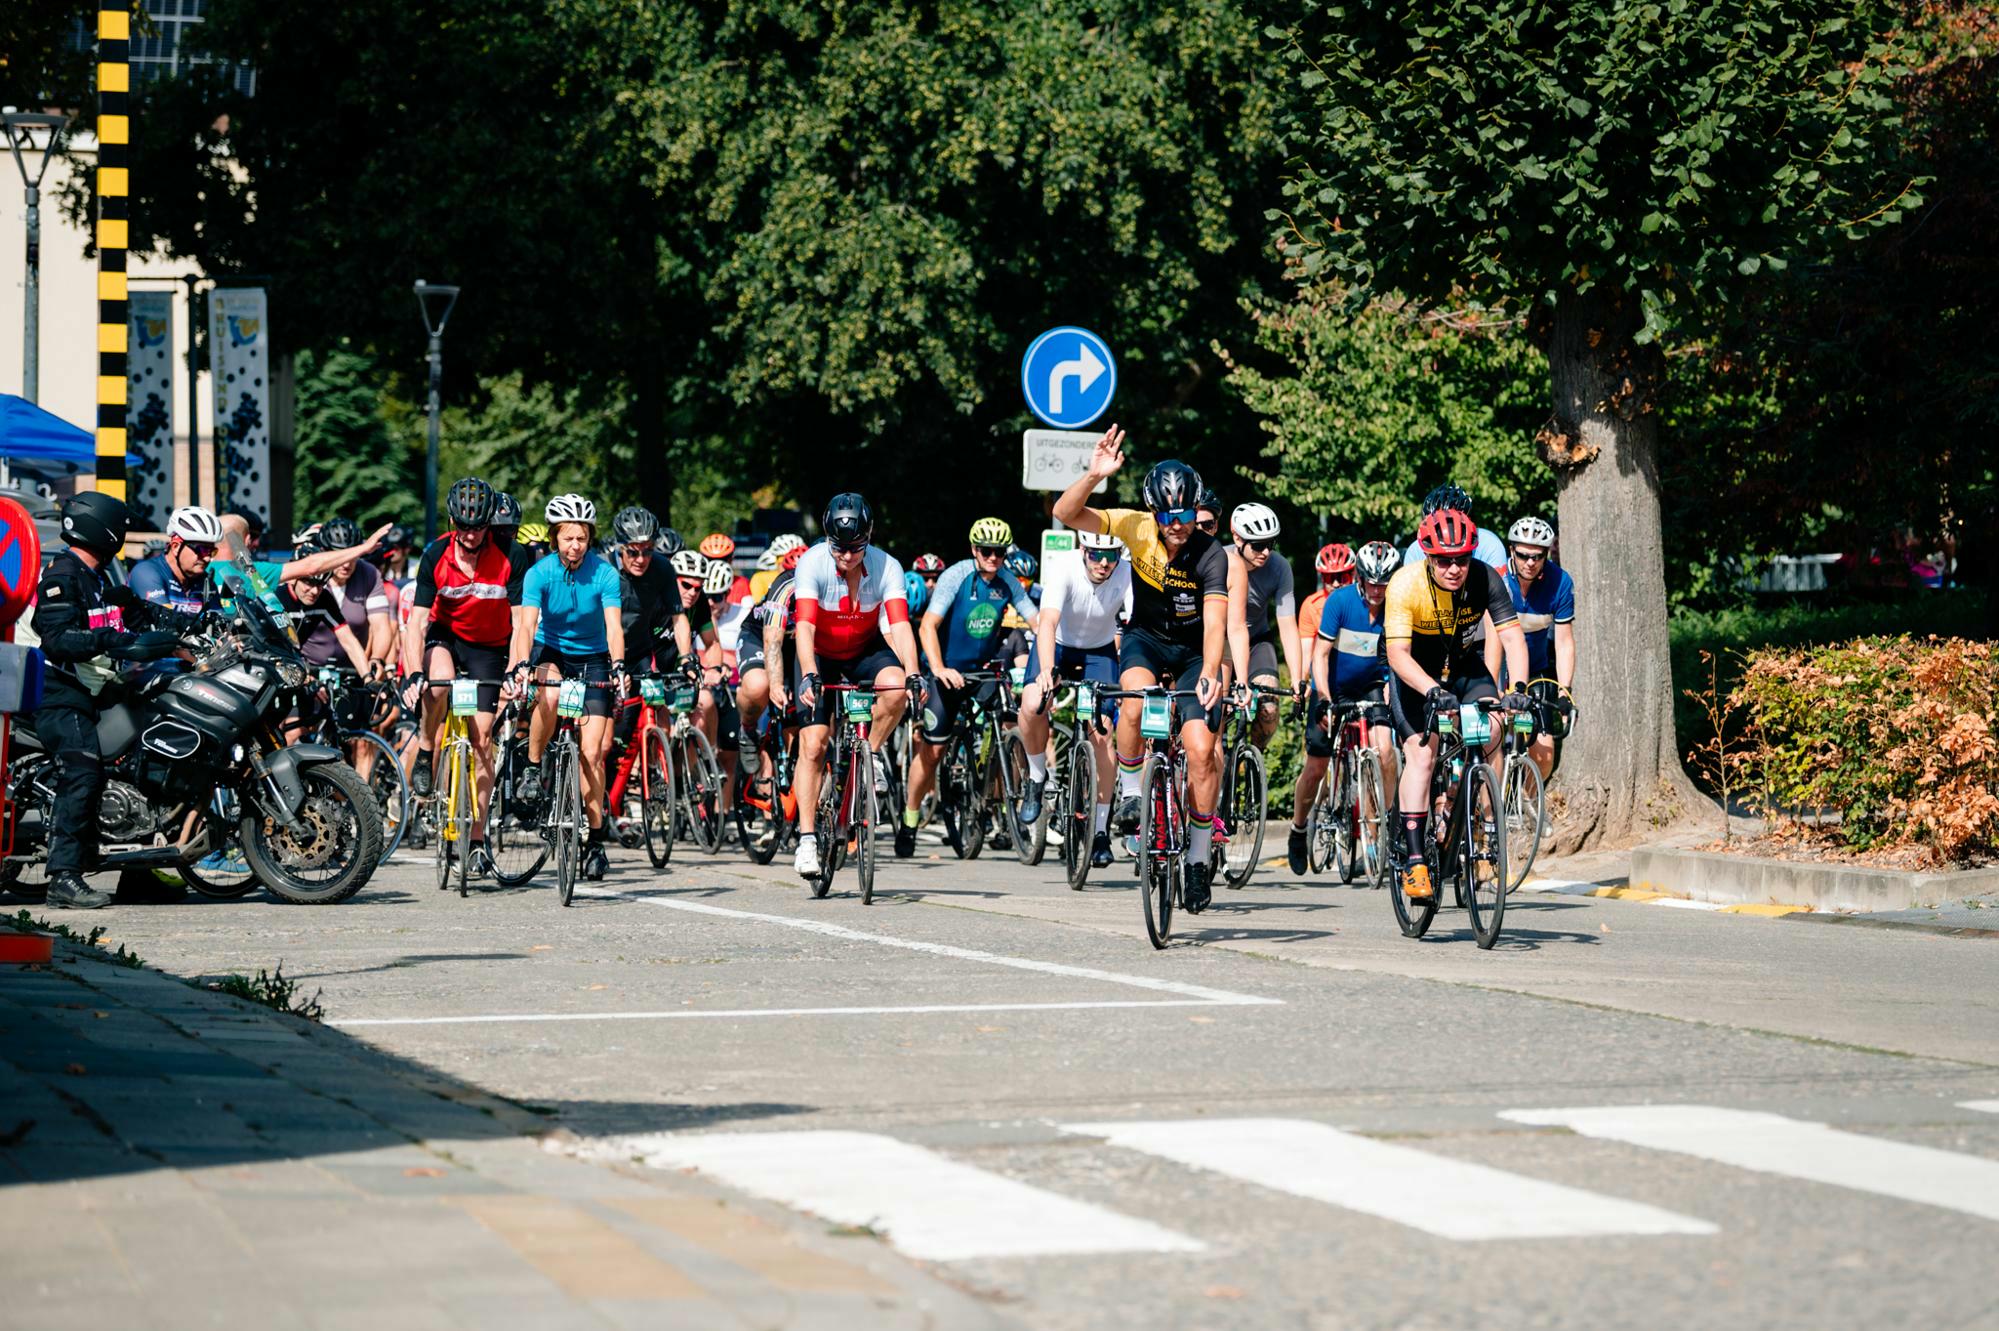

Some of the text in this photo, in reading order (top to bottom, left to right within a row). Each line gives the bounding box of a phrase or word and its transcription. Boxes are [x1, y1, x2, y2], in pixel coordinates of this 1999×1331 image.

[170, 601, 203, 614] TRE
[968, 618, 994, 629] NICO
[852, 699, 869, 708] 569
